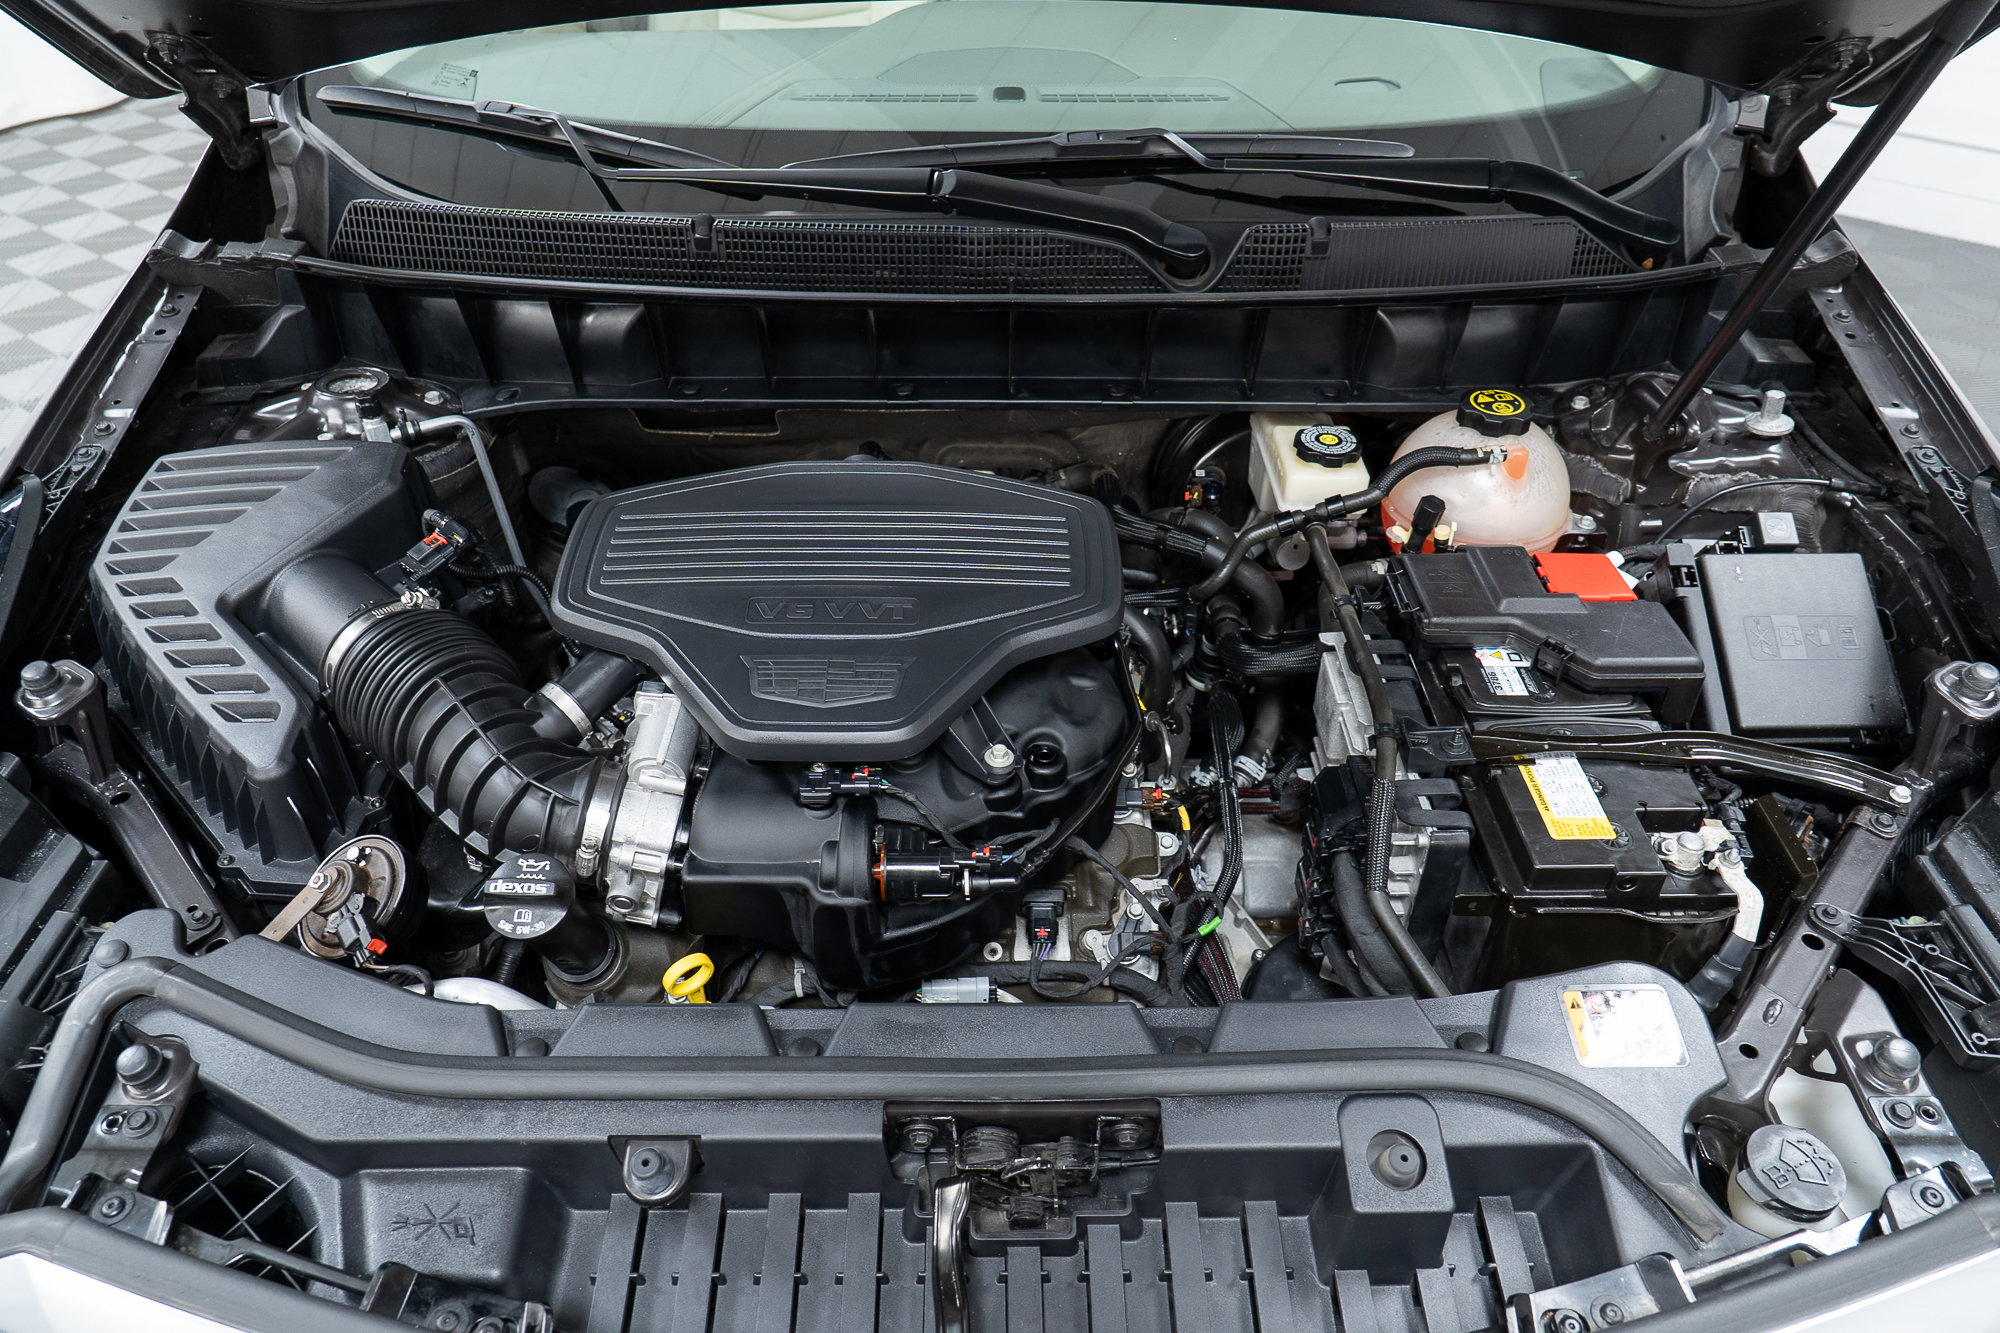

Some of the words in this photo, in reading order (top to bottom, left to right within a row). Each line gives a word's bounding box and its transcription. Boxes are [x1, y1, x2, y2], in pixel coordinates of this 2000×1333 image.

[754, 601, 814, 619] V6
[824, 601, 913, 620] VVT
[1523, 764, 1536, 783] POISO
[1532, 783, 1547, 805] DANGER
[489, 879, 550, 894] dexos
[497, 919, 515, 933] SAE
[515, 920, 546, 935] 5W-30
